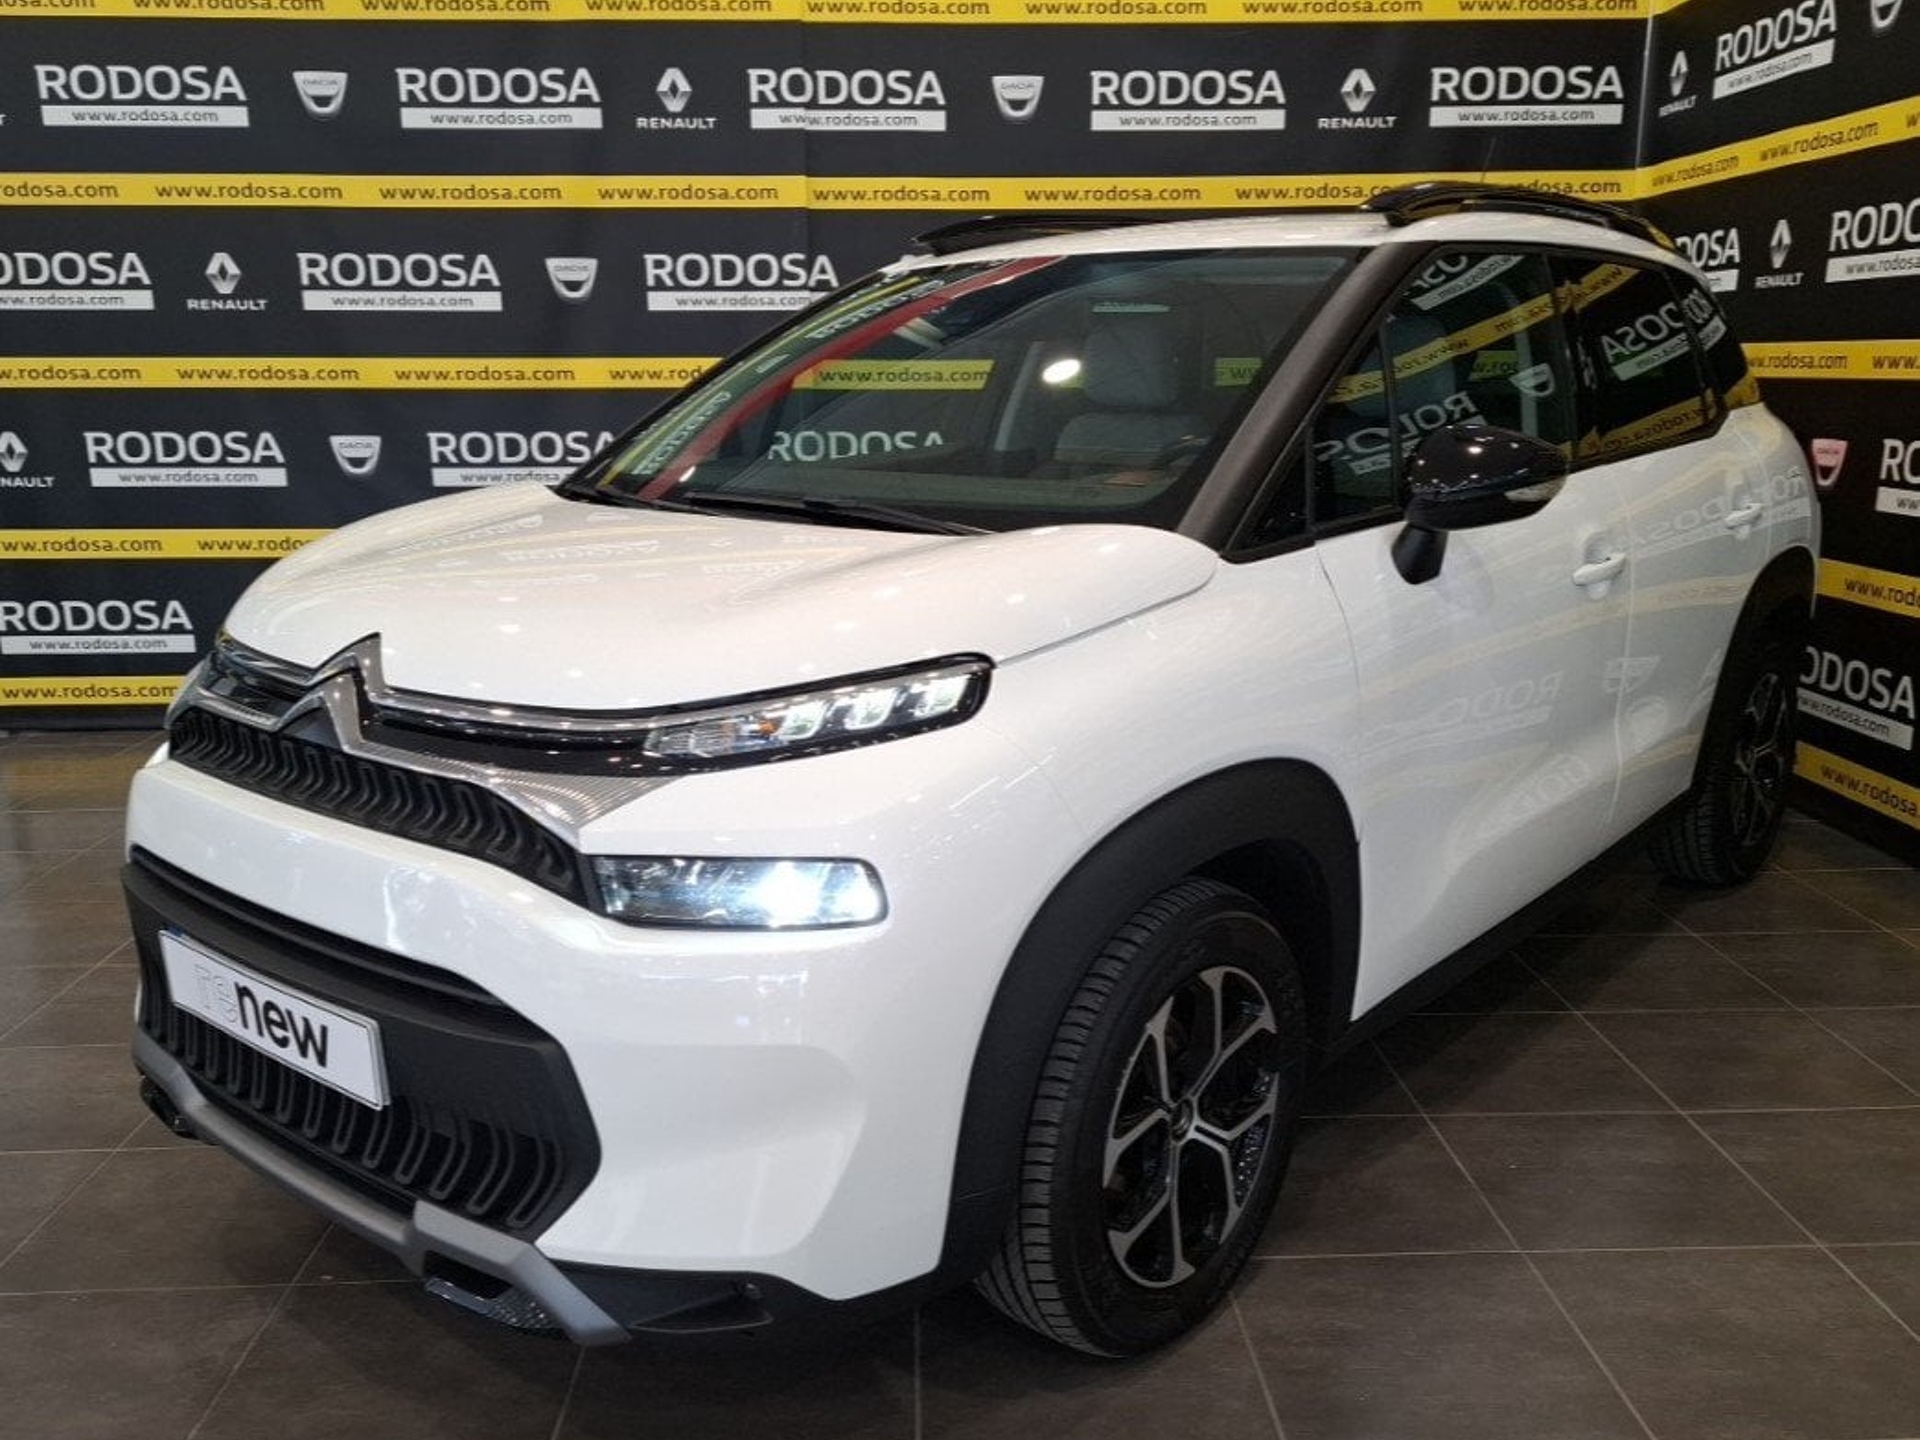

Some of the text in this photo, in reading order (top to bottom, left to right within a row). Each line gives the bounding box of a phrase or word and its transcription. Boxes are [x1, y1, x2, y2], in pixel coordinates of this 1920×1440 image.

[807, 0, 991, 15] www.rodosa.com
[1026, 0, 1207, 15] www.rodosa.com
[1243, 0, 1422, 13] www.rodosa.com
[1715, 0, 1837, 72] RODOSA
[34, 65, 247, 101] RODOSA
[396, 68, 602, 103] RODOSA
[747, 67, 946, 105] RODOSA
[1090, 70, 1286, 106] RODOSA
[1431, 66, 1624, 101] RODOSA
[72, 109, 219, 122] www.rodosa.com
[430, 112, 573, 125] www.rodosa.com
[779, 113, 918, 127] www.rodosa.com
[1119, 114, 1257, 127] www.rodosa.com
[1318, 116, 1398, 129] RENAULT
[1458, 108, 1595, 122] www.rodosa.com
[636, 117, 717, 129] RENAULT
[1760, 121, 1879, 162] www.rodosa.com
[1652, 155, 1739, 187] www.rodosa.com
[155, 183, 342, 199] www.rodosa.com
[379, 185, 562, 201] www.rodosa.com
[598, 184, 779, 201] www.rodosa.com
[813, 186, 990, 202] www.rodosa.com
[1025, 186, 1200, 201] www.rodosa.com
[296, 252, 500, 287] RODOSA
[643, 253, 839, 288] RODOSA
[1755, 272, 1804, 289] RENAULT
[187, 299, 267, 310] RENAULT
[331, 295, 473, 308] www.rodosa.com
[177, 366, 360, 381] www.rodosa.com
[394, 367, 575, 381] www.rodosa.com
[83, 431, 285, 463] RODOSA
[118, 471, 258, 482] www.rodosa.com
[0, 601, 192, 631] RODOSA
[29, 637, 167, 650] www.rodosa.com
